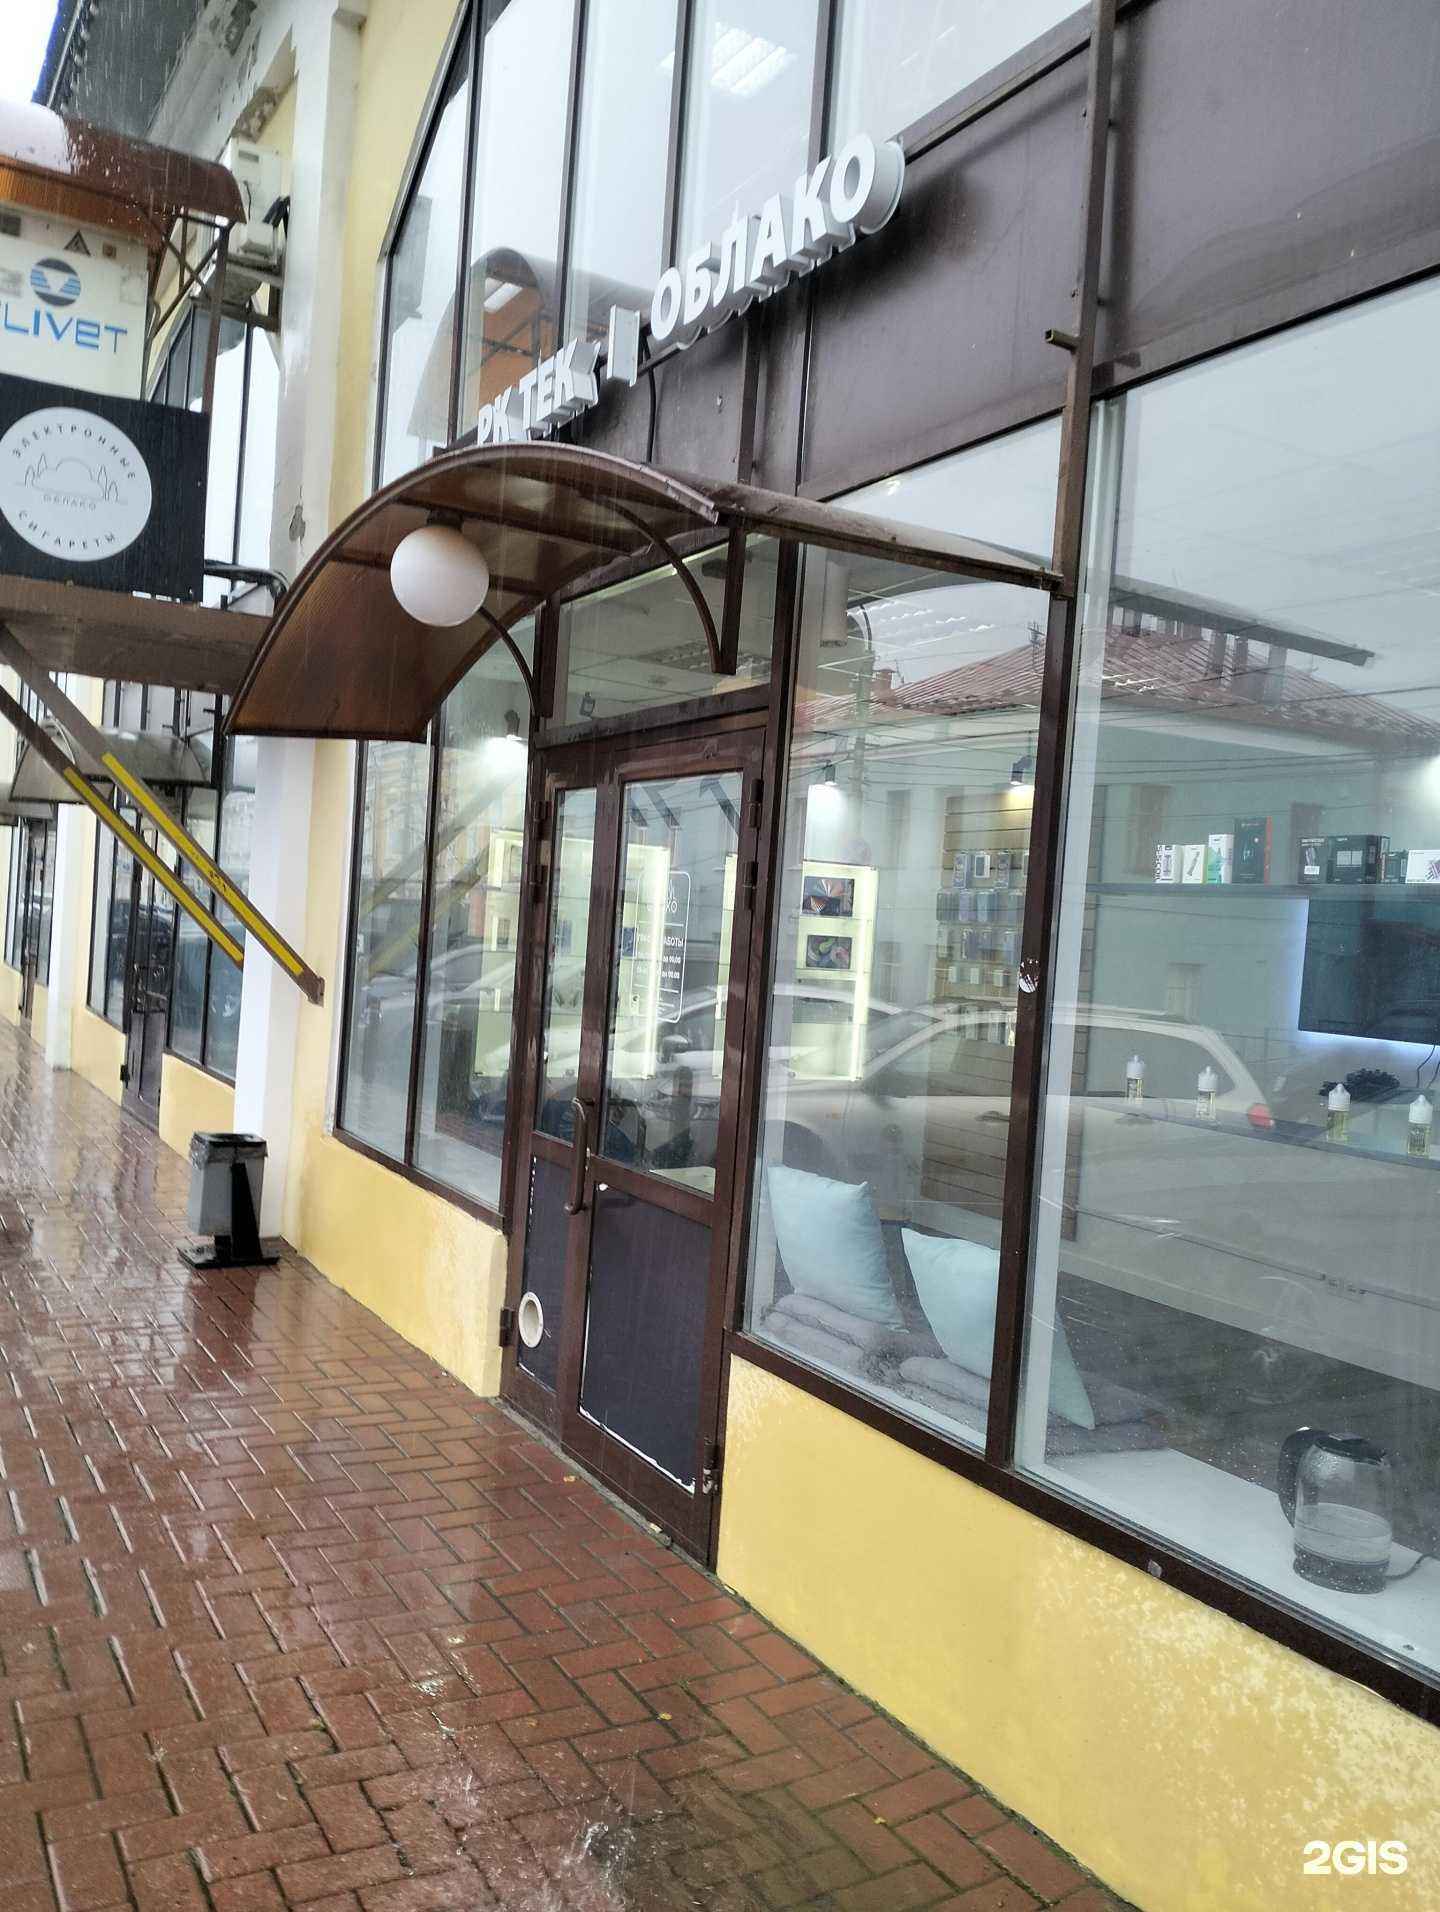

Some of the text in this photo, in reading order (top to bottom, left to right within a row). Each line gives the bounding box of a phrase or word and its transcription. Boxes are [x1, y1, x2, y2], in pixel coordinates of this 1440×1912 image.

[651, 132, 902, 346] ОБЛАКО
[0, 302, 128, 353] LIVET
[13, 422, 136, 479] ЭЛЕКТРОННЫЕ
[18, 510, 116, 550] СИГАРЕТЫ
